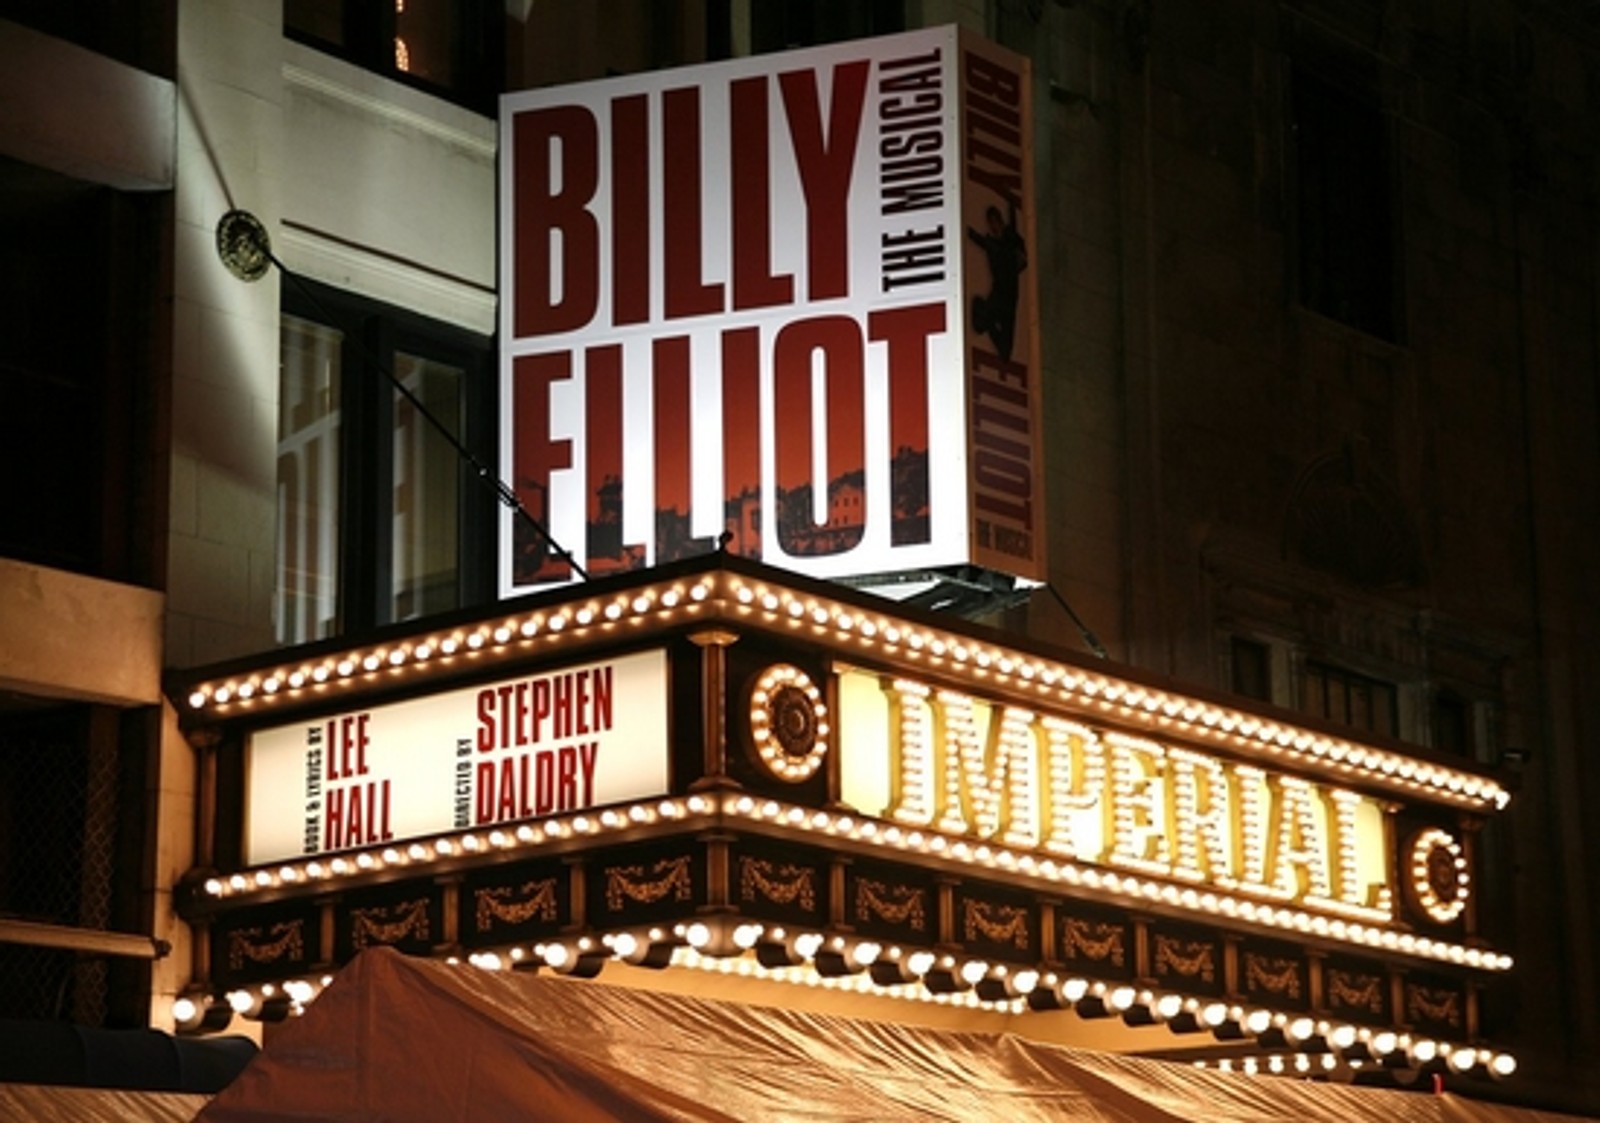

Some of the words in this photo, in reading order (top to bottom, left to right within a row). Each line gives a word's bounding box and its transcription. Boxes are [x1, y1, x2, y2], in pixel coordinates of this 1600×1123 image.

[878, 46, 944, 216] MUSICAL
[965, 51, 1023, 212] BILLY
[512, 58, 872, 340] BILLY
[881, 224, 945, 293] THE
[511, 301, 947, 588] ELLIOT
[972, 346, 1034, 532] ELLIOT
[307, 727, 322, 746] BY
[327, 713, 371, 781] LEE
[456, 738, 472, 758] BY
[476, 665, 613, 754] STEPHEN
[324, 779, 394, 851] HALL
[475, 741, 599, 826] DALDRY
[880, 676, 1394, 924] IMPERIAL
